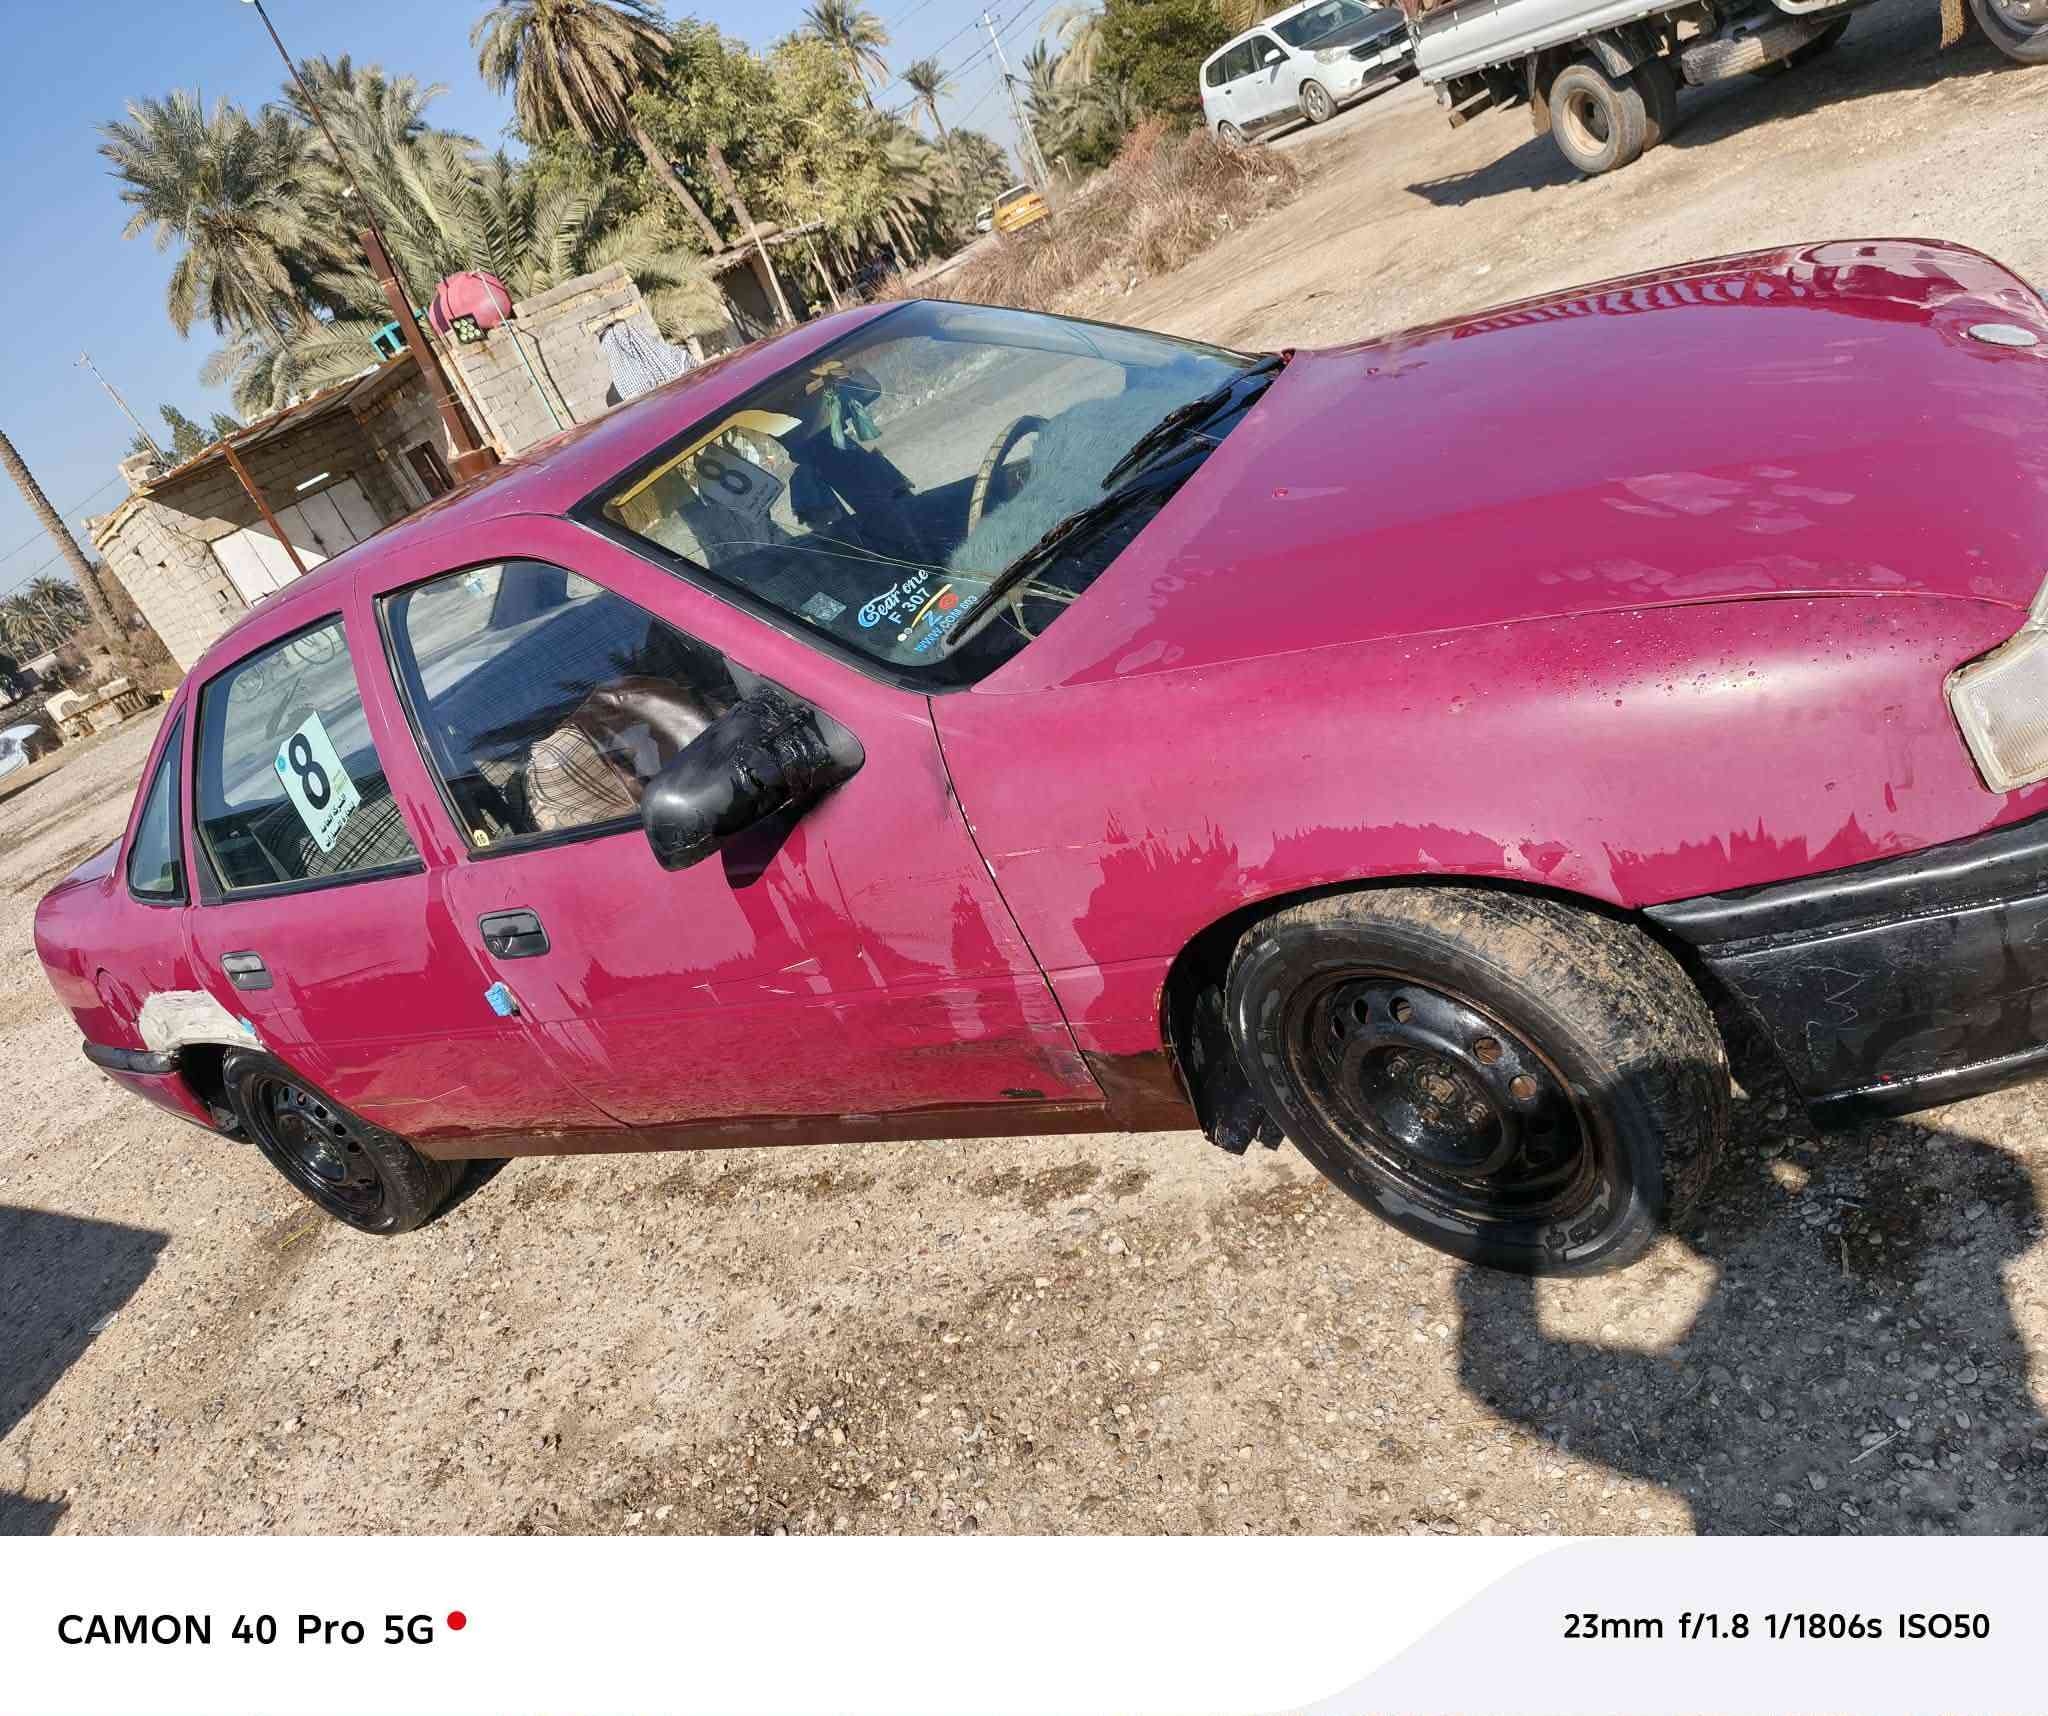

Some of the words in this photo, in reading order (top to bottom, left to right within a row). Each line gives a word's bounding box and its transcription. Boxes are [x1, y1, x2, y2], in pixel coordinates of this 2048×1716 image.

[901, 568, 929, 594] one
[887, 610, 903, 626] F
[901, 586, 932, 613] 307
[288, 733, 331, 810] 8
